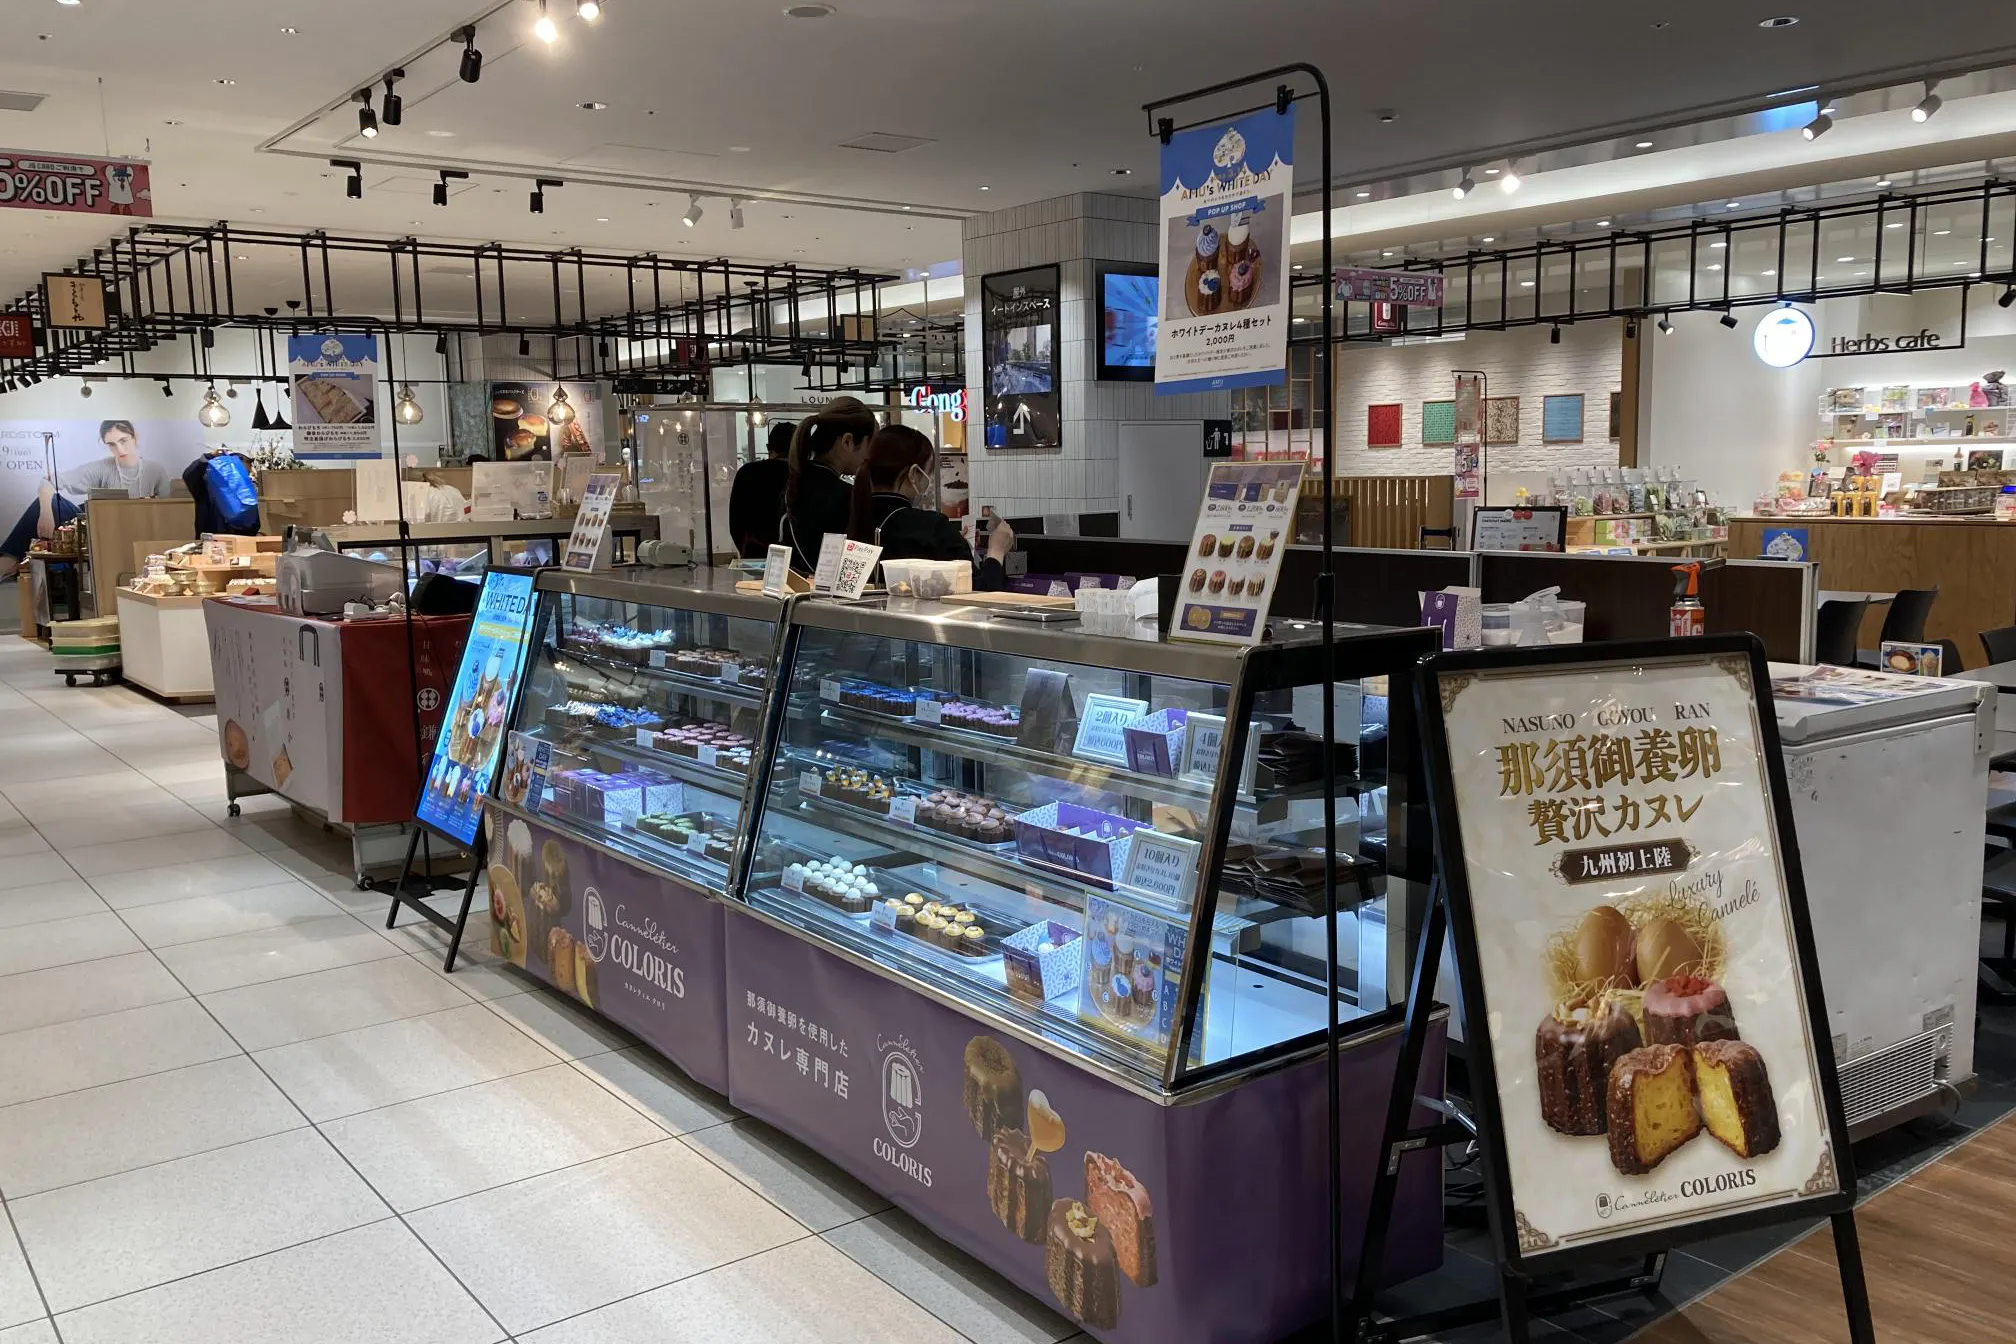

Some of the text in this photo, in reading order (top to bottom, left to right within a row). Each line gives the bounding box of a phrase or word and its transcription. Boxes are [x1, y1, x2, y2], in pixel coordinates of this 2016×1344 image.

[1181, 185, 1214, 201] AMU's
[1217, 175, 1250, 192] WHITE
[1253, 168, 1273, 185] DAY
[1207, 201, 1246, 216] POP UP SHOP
[1013, 286, 1026, 299] 屋外
[1390, 276, 1427, 301] 5%OFF
[992, 298, 1050, 316] イートインスペース
[1171, 314, 1271, 339] ホワイトデーカヌレ4種セット
[1206, 333, 1235, 346] 2,000円
[1832, 328, 1940, 353] Herbs cafe
[7, 460, 43, 470] OPEN
[1095, 711, 1128, 726] 2個入り
[1502, 702, 1711, 734] NASUNO GOYOU RAN
[1494, 725, 1722, 797] 那須御養卵
[1527, 794, 1704, 846] 贅沢カヌレ
[1144, 848, 1180, 867] 10個入り
[1580, 845, 1673, 878] 九州初上陸
[1669, 869, 1723, 910] Luxury
[1698, 878, 1760, 928] Cannelé
[610, 934, 685, 998] COLORIS
[746, 989, 849, 1058] 那須御養卵を使用した
[747, 1021, 849, 1100] カヌレ専門店
[873, 1137, 932, 1188] COLORIS
[1680, 1168, 1757, 1198] COLORIS
